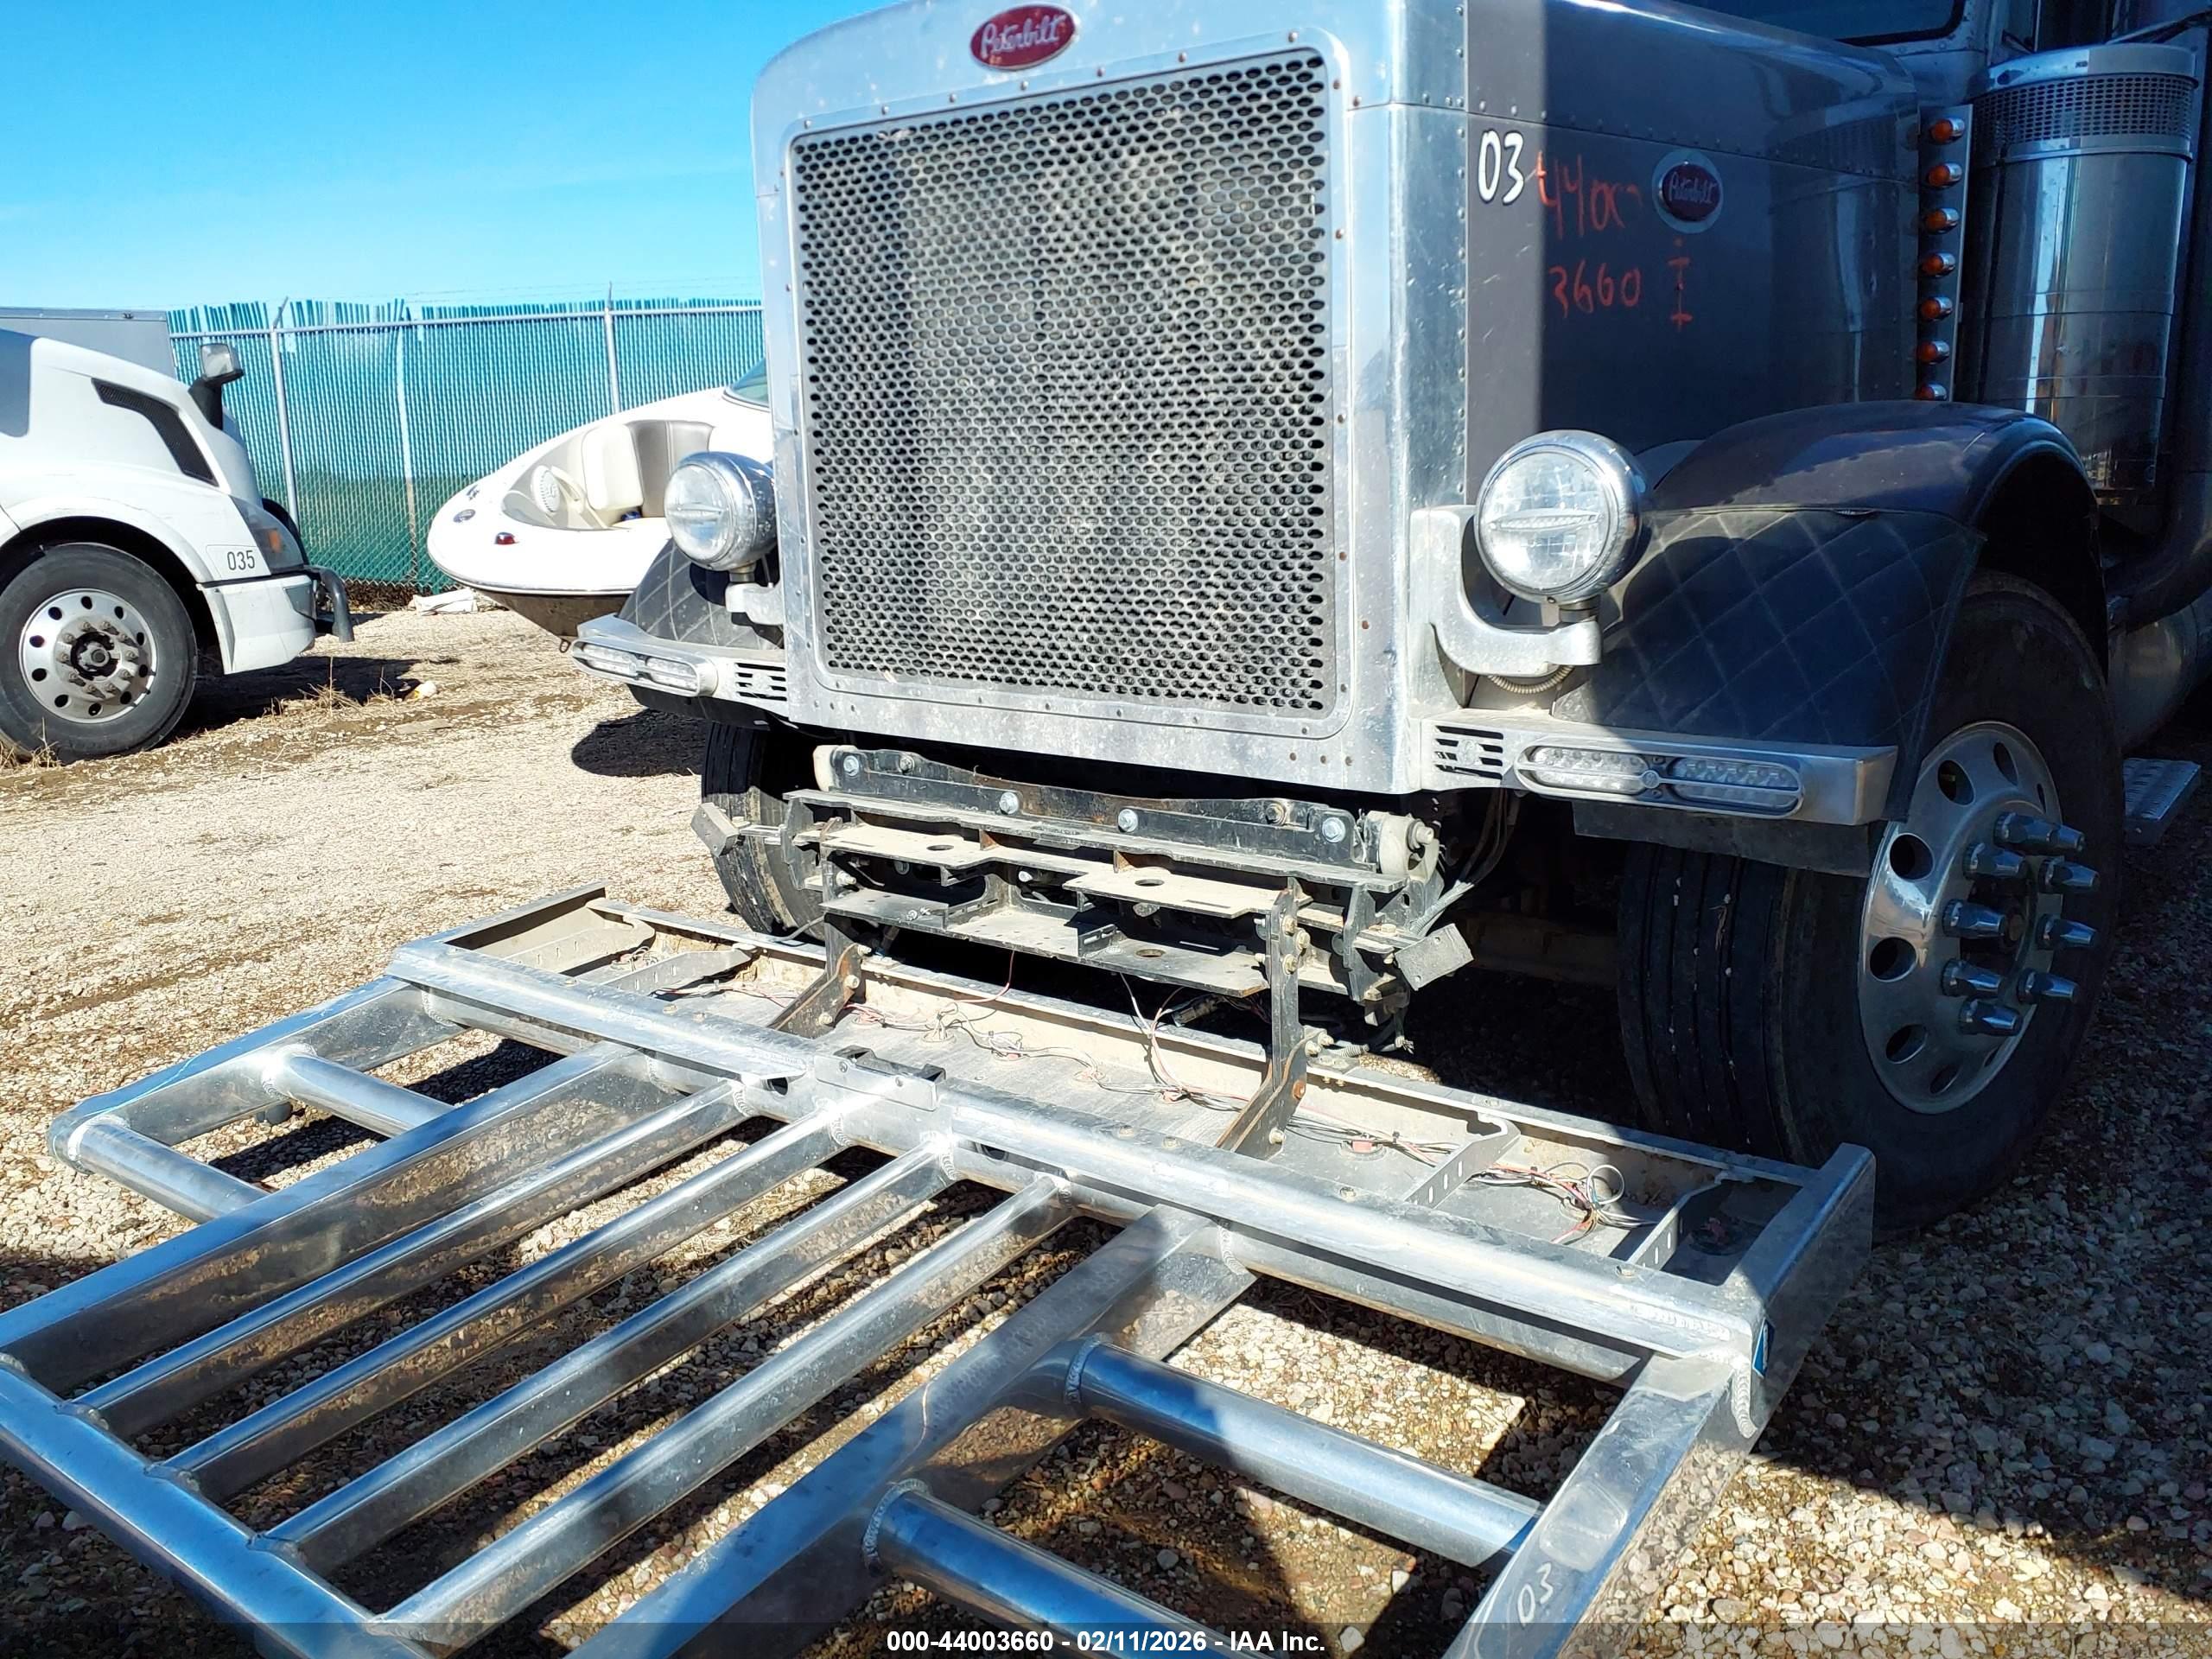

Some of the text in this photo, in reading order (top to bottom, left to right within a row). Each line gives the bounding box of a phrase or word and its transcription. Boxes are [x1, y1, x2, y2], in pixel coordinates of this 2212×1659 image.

[980, 14, 1066, 60] Peterbilt
[1477, 129, 1525, 205] 03
[1548, 258, 1641, 319] 3660
[226, 550, 256, 571] 035
[1517, 1561, 1554, 1629] 03
